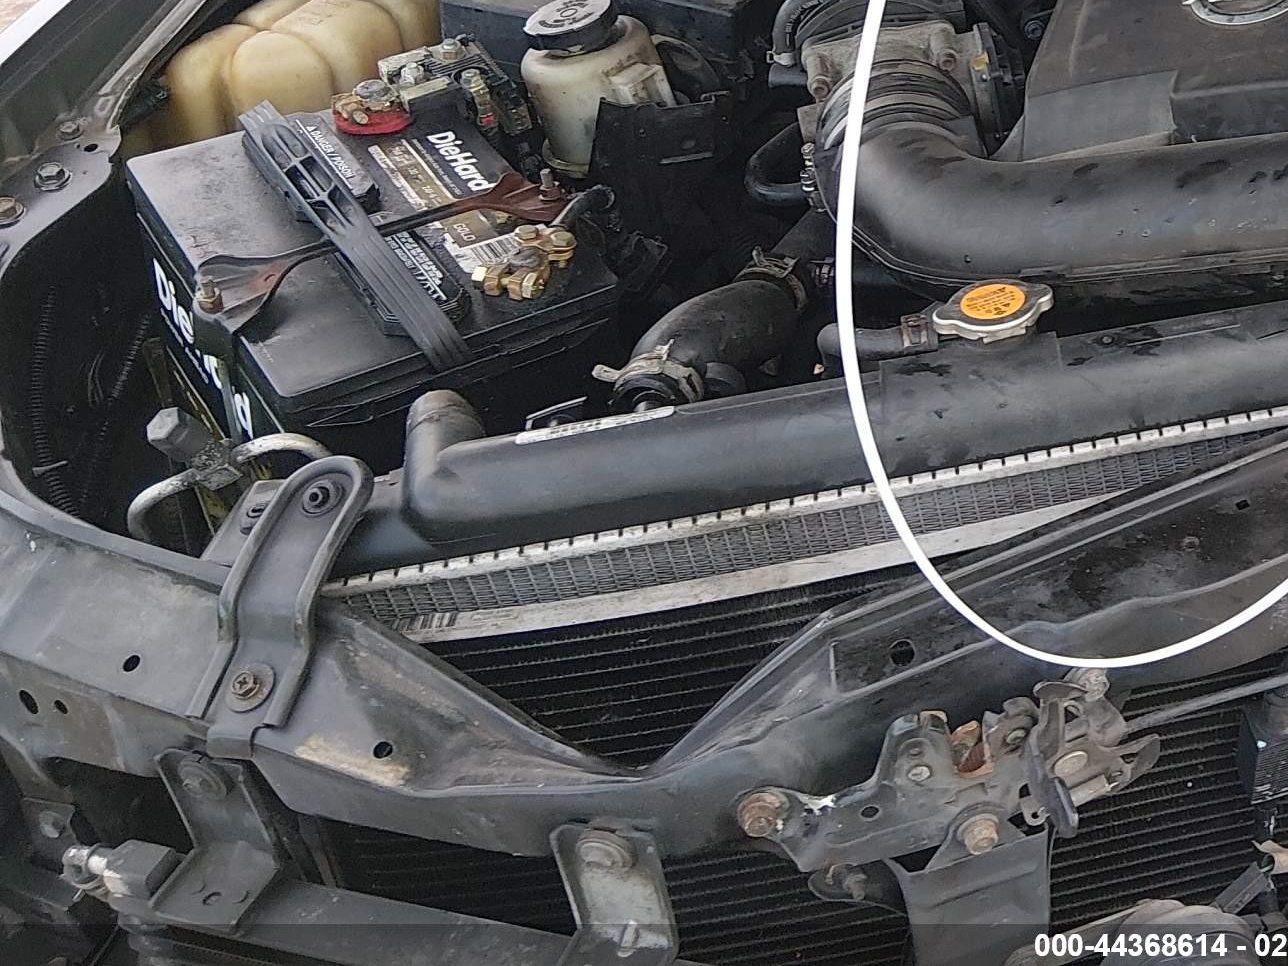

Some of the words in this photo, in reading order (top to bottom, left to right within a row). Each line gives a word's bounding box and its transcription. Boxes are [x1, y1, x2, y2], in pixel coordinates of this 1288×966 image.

[310, 130, 336, 154] DANGER
[329, 156, 357, 179] POISON
[426, 131, 497, 192] DieHard
[453, 223, 477, 242] GOLD
